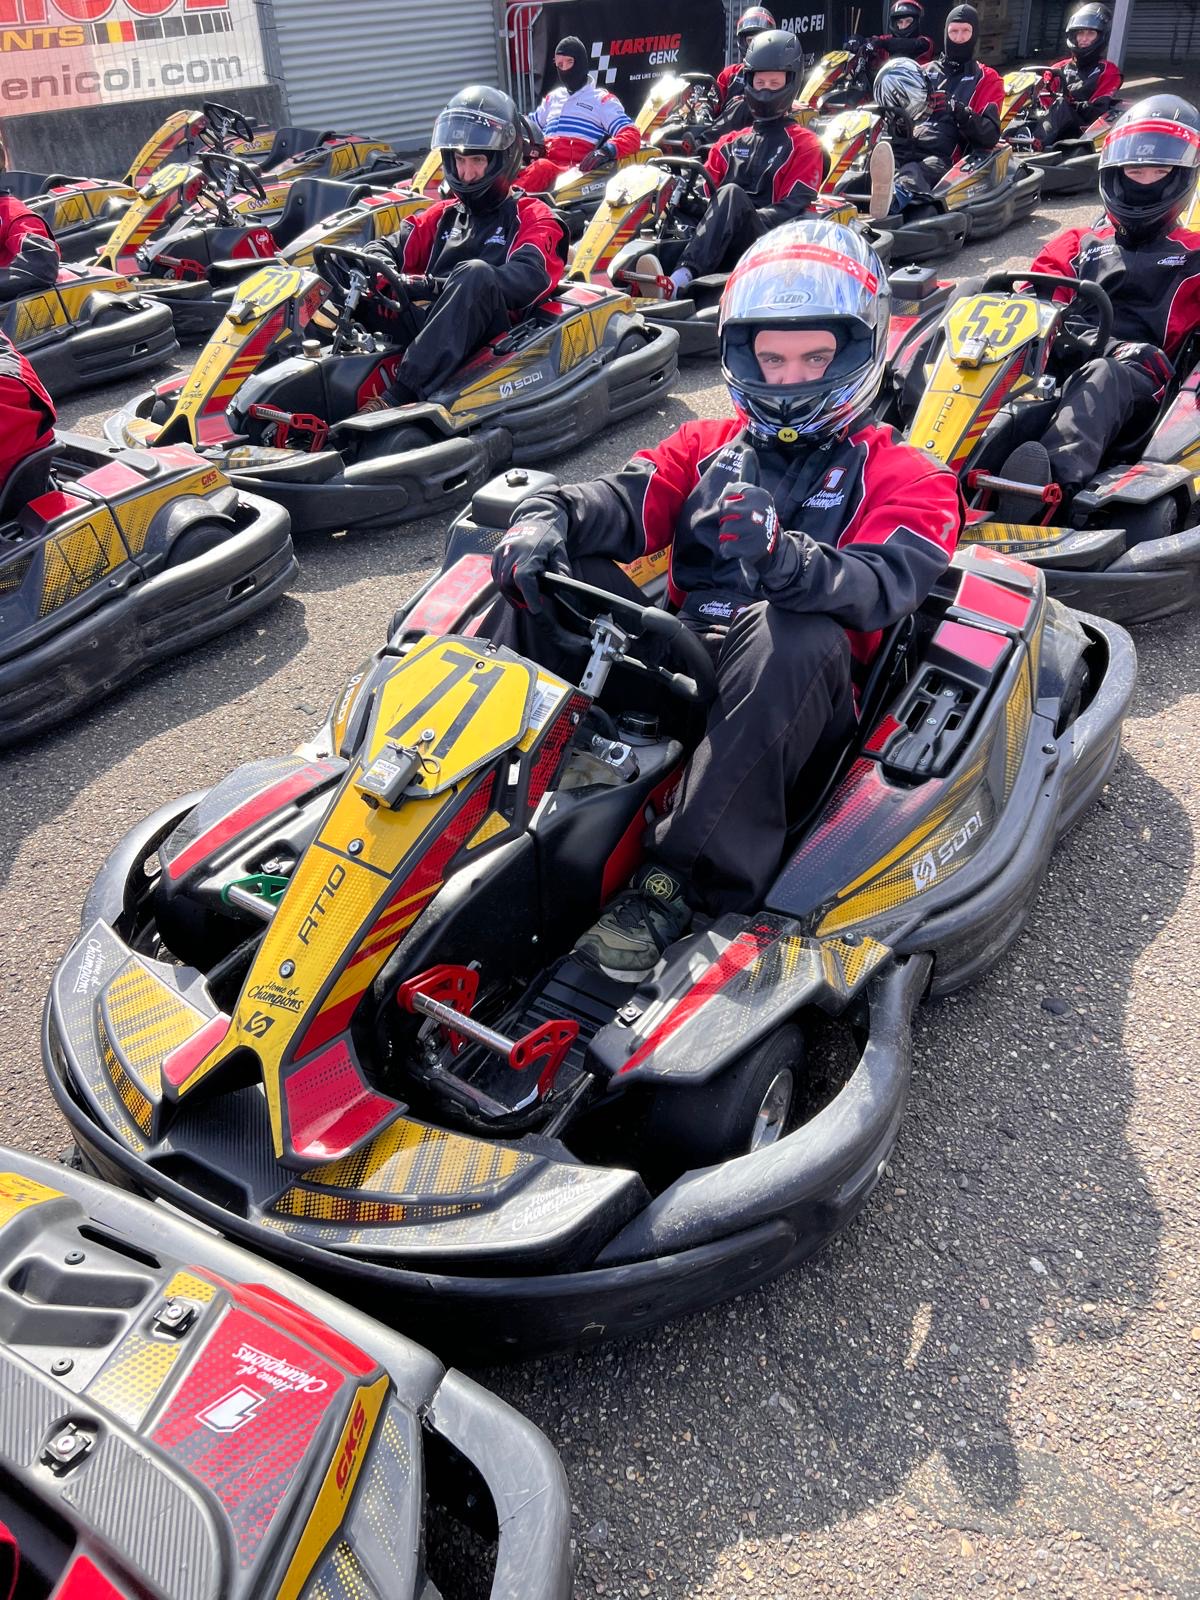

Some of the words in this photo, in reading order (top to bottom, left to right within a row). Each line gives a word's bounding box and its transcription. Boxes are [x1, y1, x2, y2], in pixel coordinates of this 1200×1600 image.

[781, 16, 809, 33] PARC
[0, 25, 86, 51] NTS
[610, 33, 682, 56] KARTING
[648, 49, 680, 66] GENK
[774, 293, 806, 304] LAZER
[958, 300, 1029, 347] 53
[514, 371, 543, 390] SODI
[932, 396, 955, 433] RT10
[201, 470, 217, 486] GKS
[384, 649, 507, 760] 71
[297, 863, 347, 946] RT10
[74, 938, 102, 995] Champions
[247, 984, 305, 1011] Champions
[264, 981, 287, 994] Home
[286, 986, 301, 997] of
[231, 1345, 329, 1393] Champions
[255, 1371, 295, 1393] Home
[335, 1399, 366, 1491] GKS
